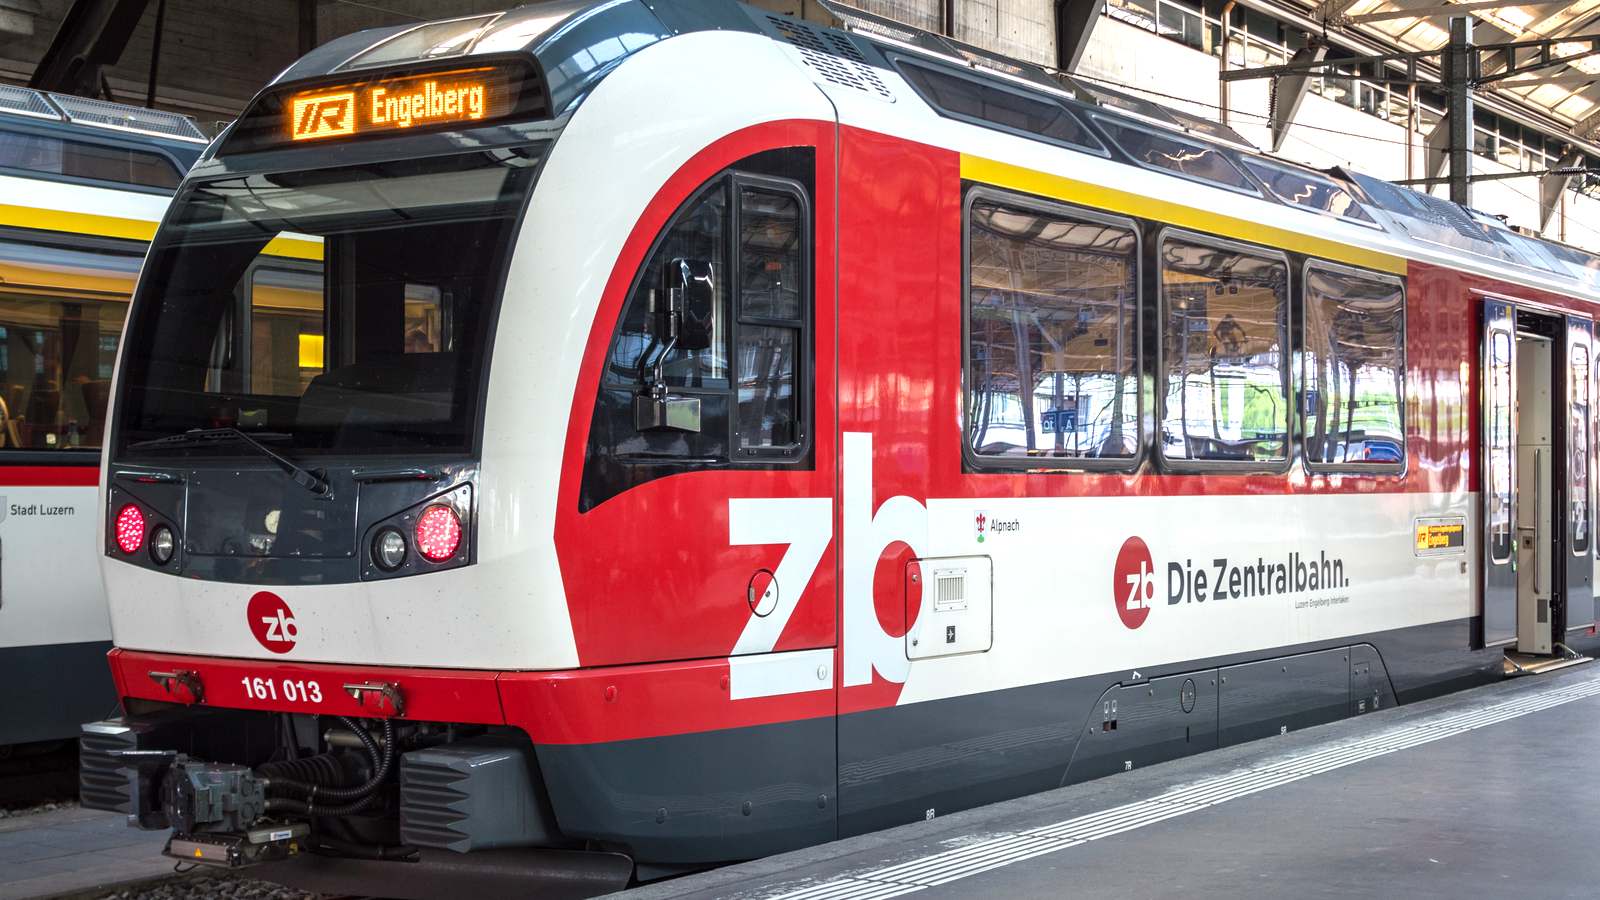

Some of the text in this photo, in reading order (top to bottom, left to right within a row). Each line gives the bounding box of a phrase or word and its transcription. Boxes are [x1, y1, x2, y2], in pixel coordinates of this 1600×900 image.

[371, 81, 484, 128] Engelberg
[10, 504, 75, 516] Stadt Luzern
[990, 518, 1020, 535] Alpnach
[728, 431, 929, 700] zb
[1126, 550, 1349, 610] zb Die Zentralbahn.
[261, 608, 299, 642] zb
[242, 677, 323, 703] 161 013
